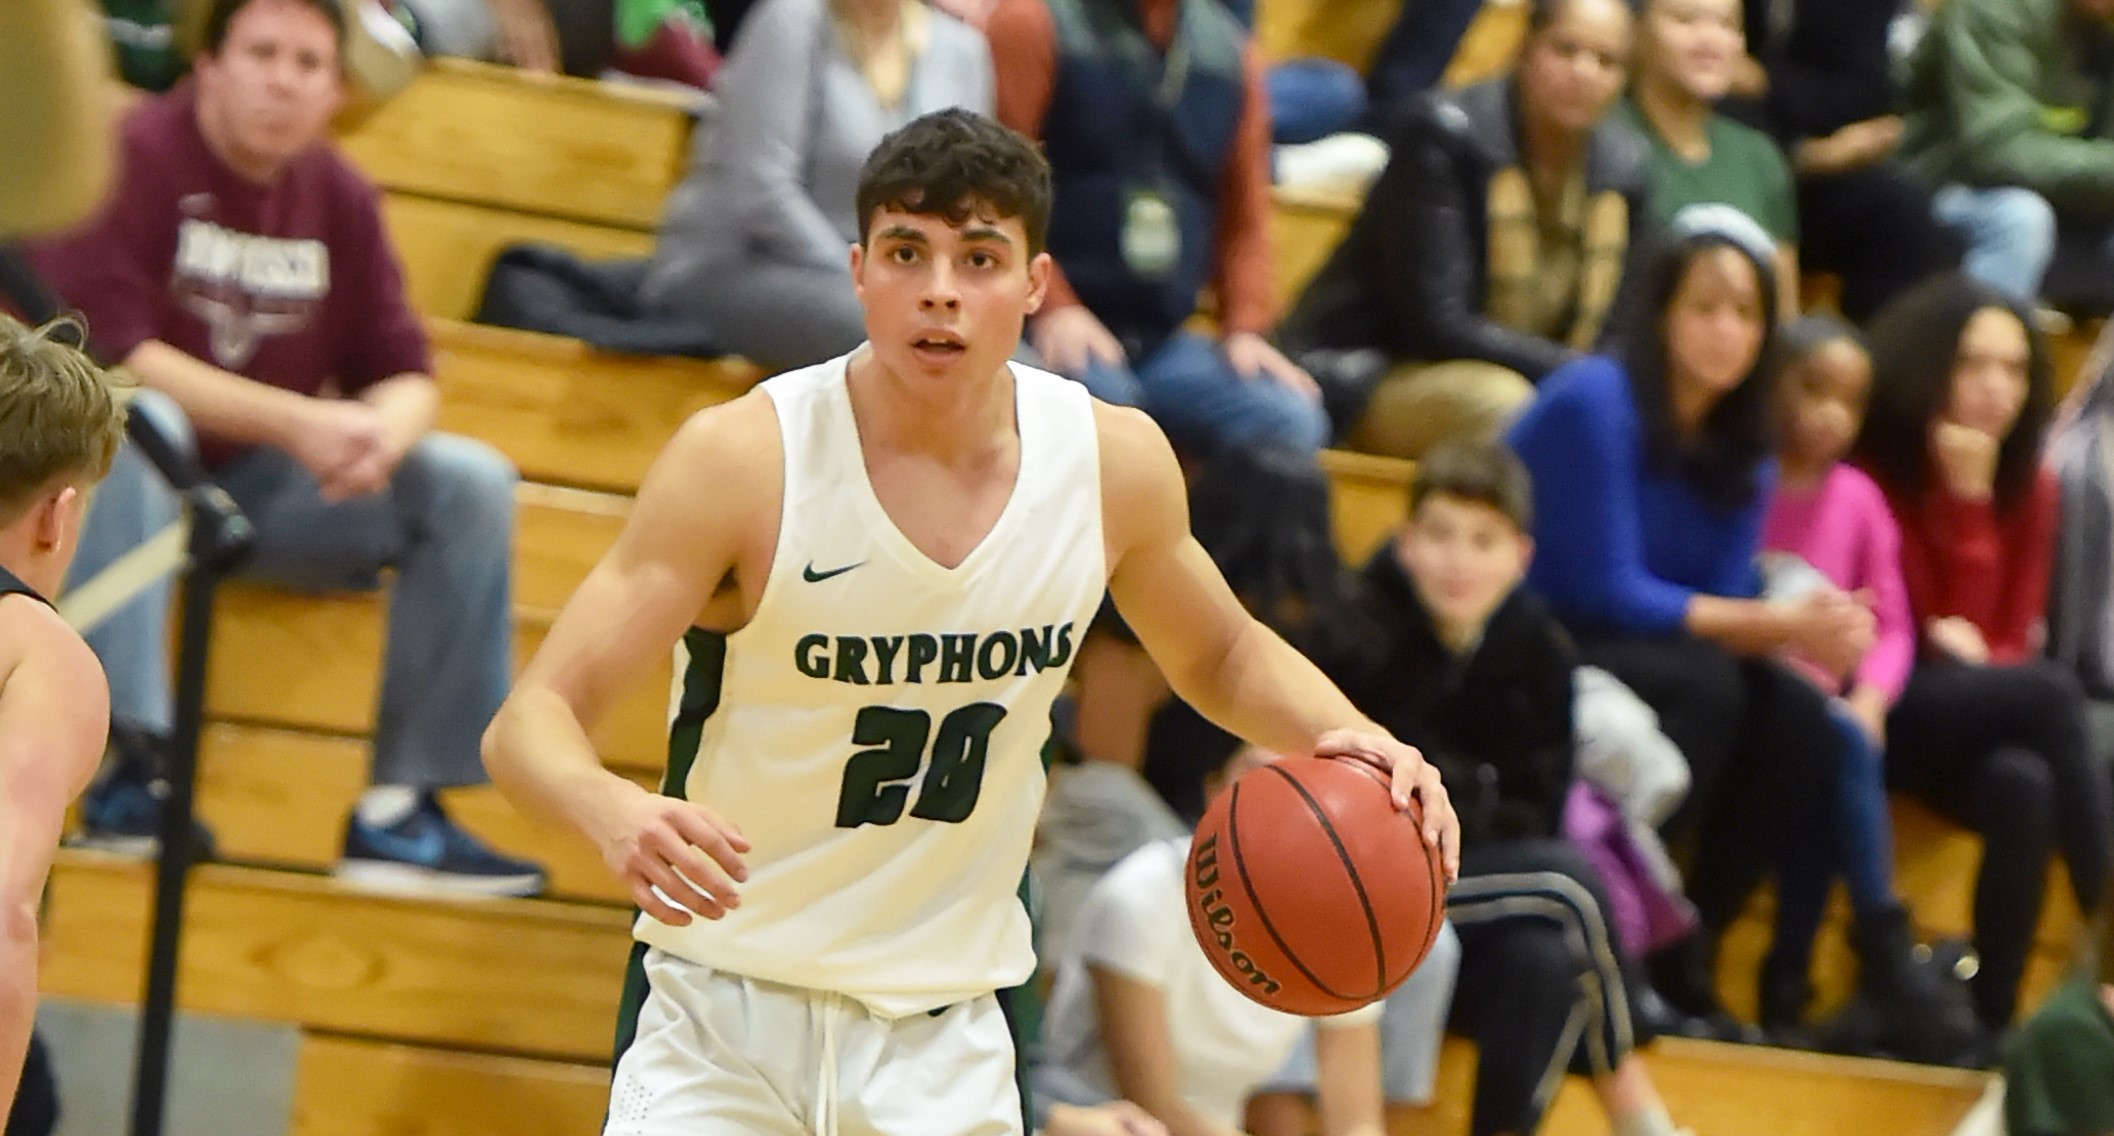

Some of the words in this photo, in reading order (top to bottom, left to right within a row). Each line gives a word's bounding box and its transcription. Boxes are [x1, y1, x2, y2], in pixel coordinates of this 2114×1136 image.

[795, 622, 1074, 685] GRYPHONS
[835, 702, 1008, 828] 20
[1194, 832, 1282, 995] Wilson
